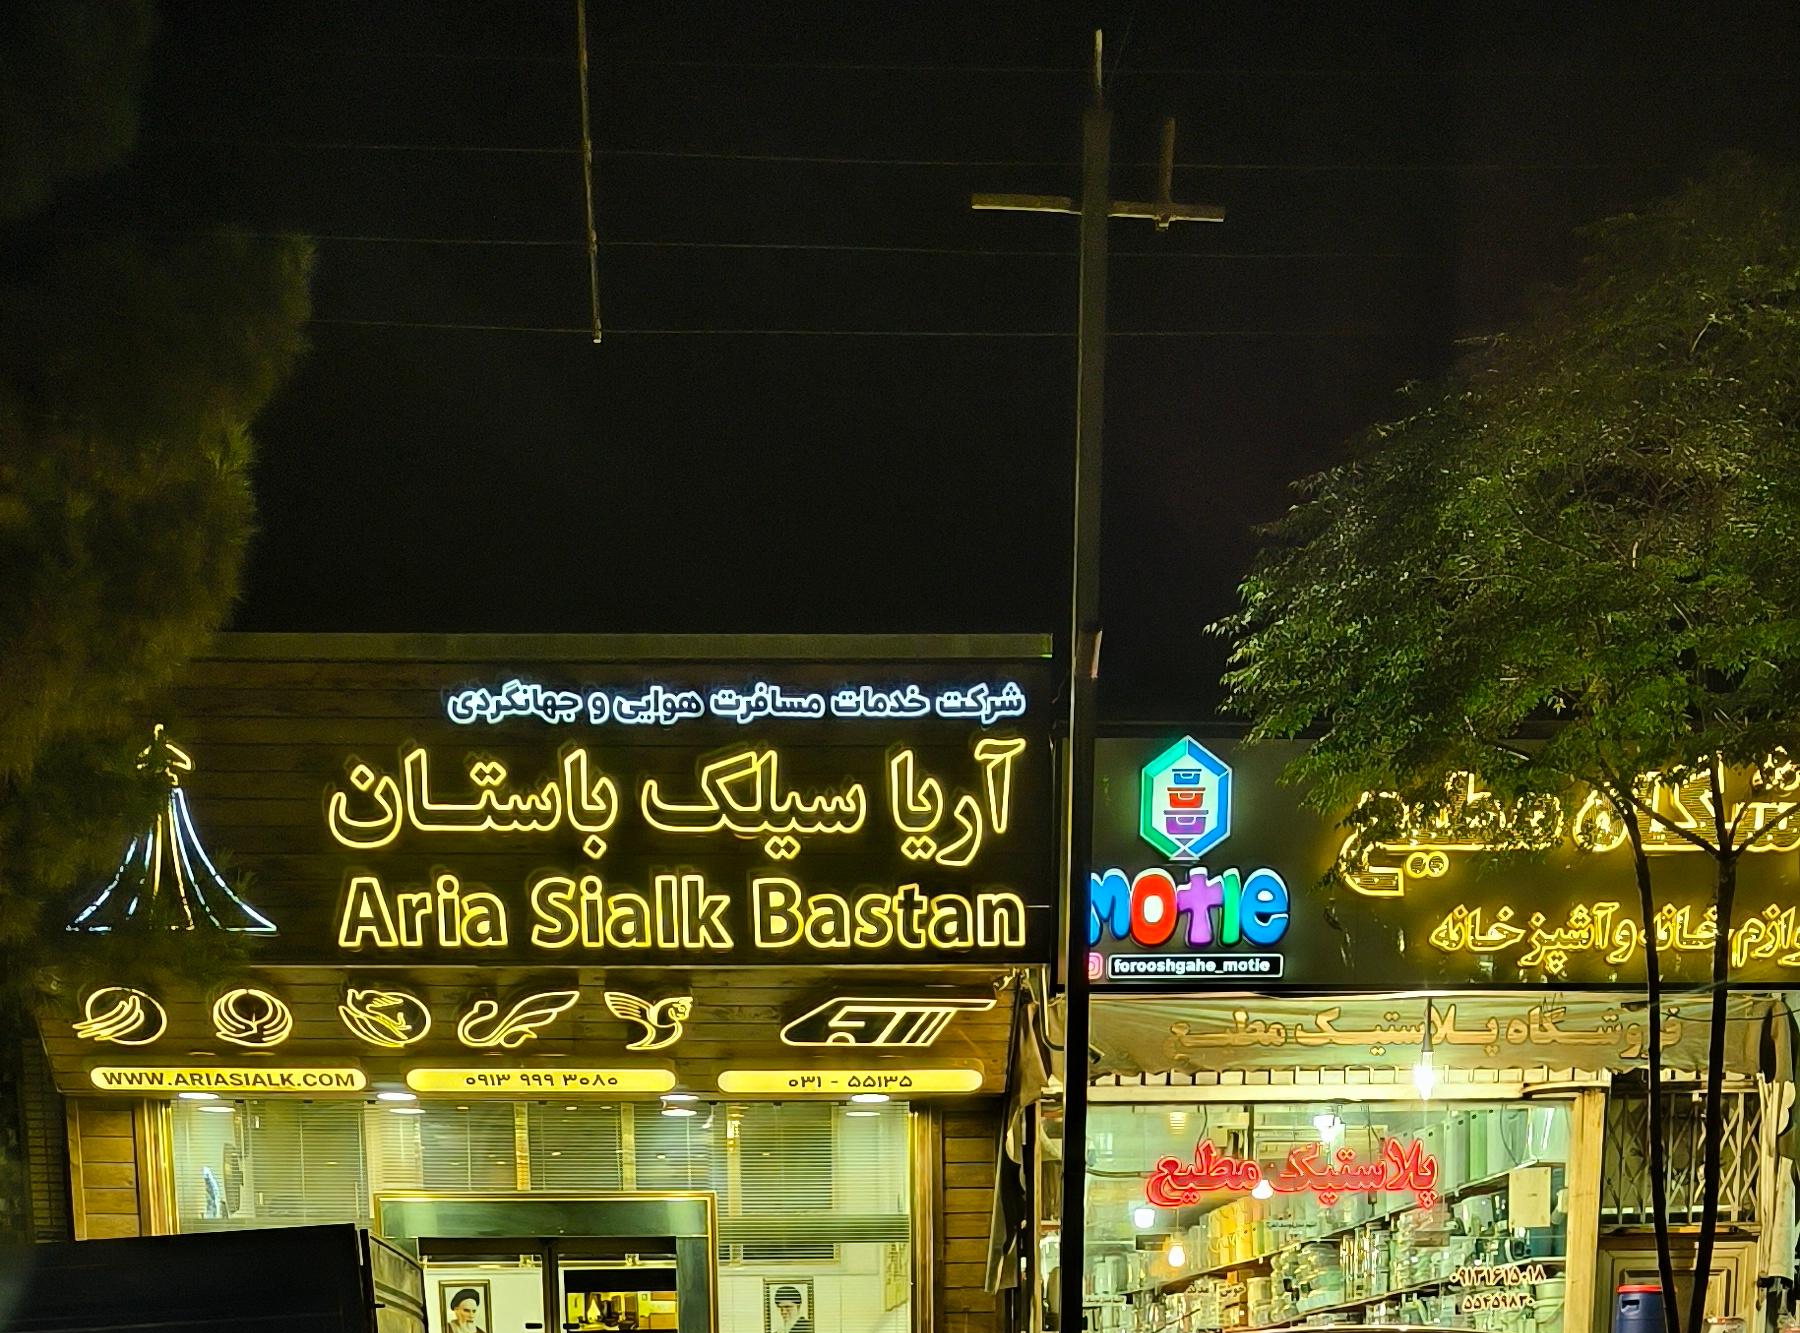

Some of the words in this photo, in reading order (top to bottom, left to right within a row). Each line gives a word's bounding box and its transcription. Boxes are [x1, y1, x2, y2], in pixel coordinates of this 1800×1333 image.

[447, 679, 583, 725] جهانگردی
[588, 691, 609, 724] و
[612, 685, 705, 725] هوایی
[710, 682, 825, 724] مسافرت
[831, 685, 931, 717] خدمات
[936, 682, 1026, 724] شرکت
[329, 748, 619, 859] باستان
[641, 750, 866, 858] سیلک
[890, 738, 1026, 868] آریا
[337, 876, 509, 950] Aria
[530, 875, 732, 949] Sialk
[752, 877, 1027, 949] Bastan
[1090, 867, 1291, 946] motie
[1113, 958, 1271, 975] forooshgahe_motie
[102, 1072, 356, 1088] WWW.ARIASIALK.COM
[465, 1073, 511, 1087] ۰۹۱۳
[519, 1073, 555, 1088] ۹۹۹
[562, 1074, 619, 1087] ۳۰۸۰
[788, 1075, 823, 1088] ۰۳۱
[847, 1074, 914, 1088] ۵۵۱۳۵
[1146, 1138, 1263, 1209] مطیع
[1269, 1137, 1440, 1208] پلاستیک
